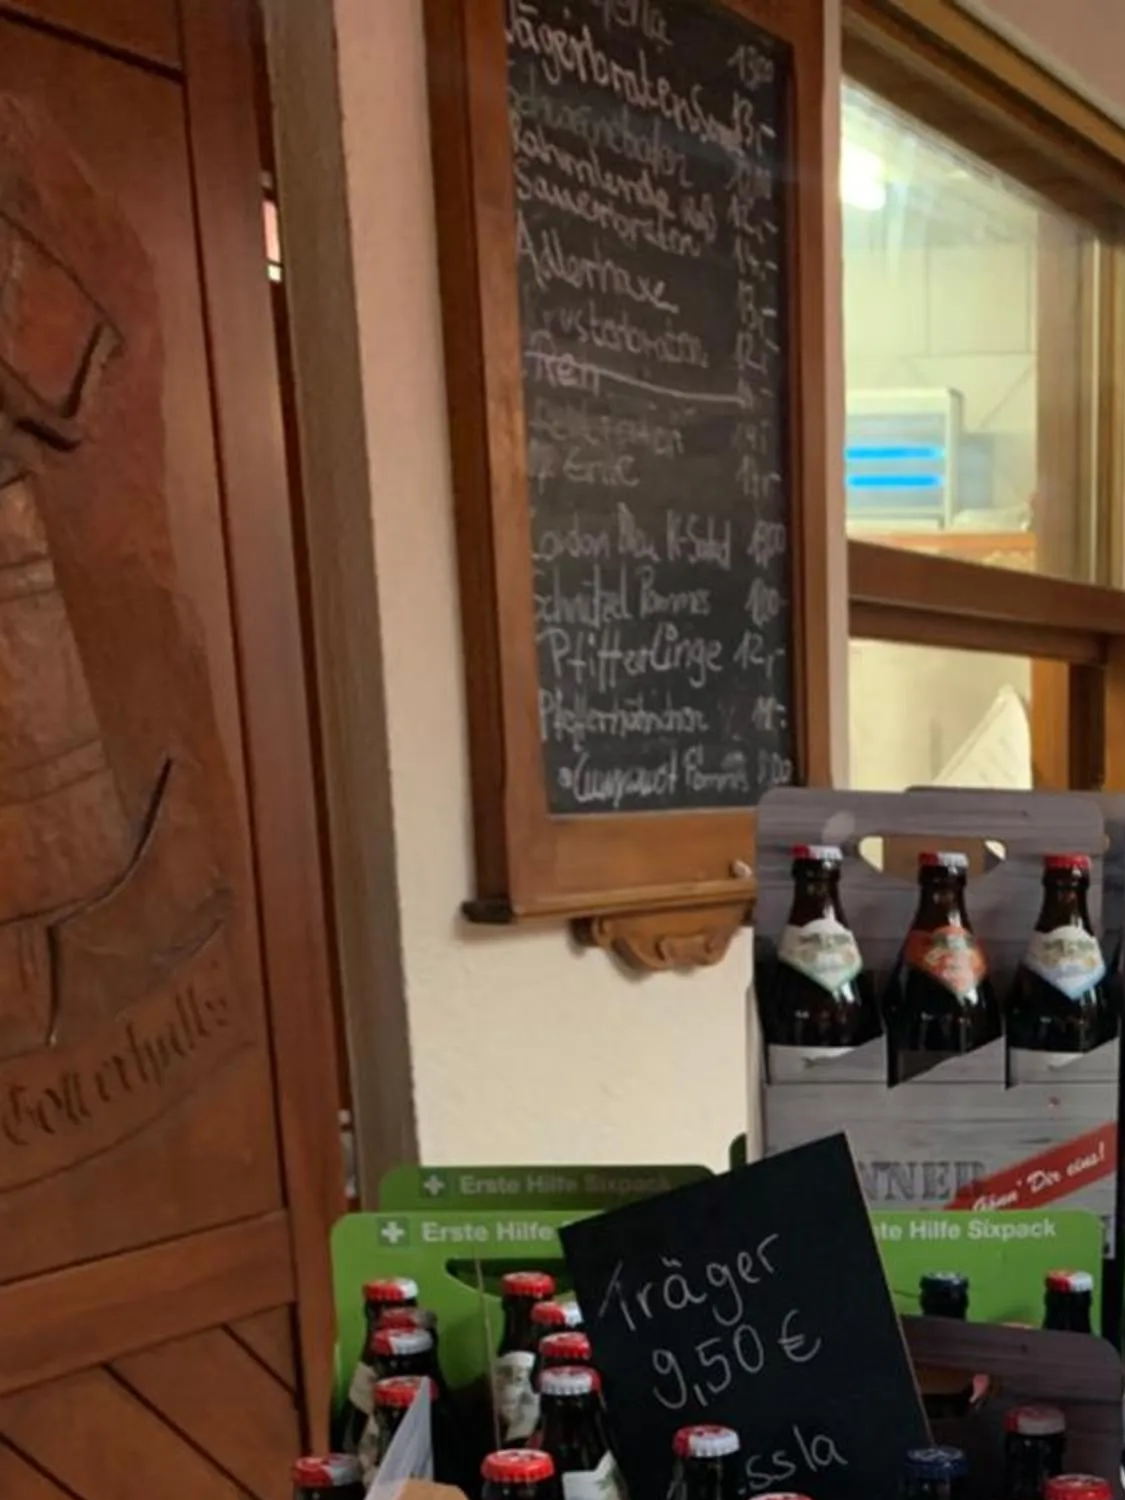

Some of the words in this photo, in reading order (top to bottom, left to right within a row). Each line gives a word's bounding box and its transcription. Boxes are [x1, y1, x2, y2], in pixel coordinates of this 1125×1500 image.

[460, 1174, 518, 1195] Erste
[527, 1174, 577, 1194] Hilfe
[421, 1221, 488, 1242] Erste
[497, 1221, 554, 1241] Hilfe
[909, 1220, 961, 1240] Hilfe
[967, 1218, 1057, 1240] Sixpack
[600, 1233, 780, 1332] Träger
[652, 1324, 765, 1410] 9,50
